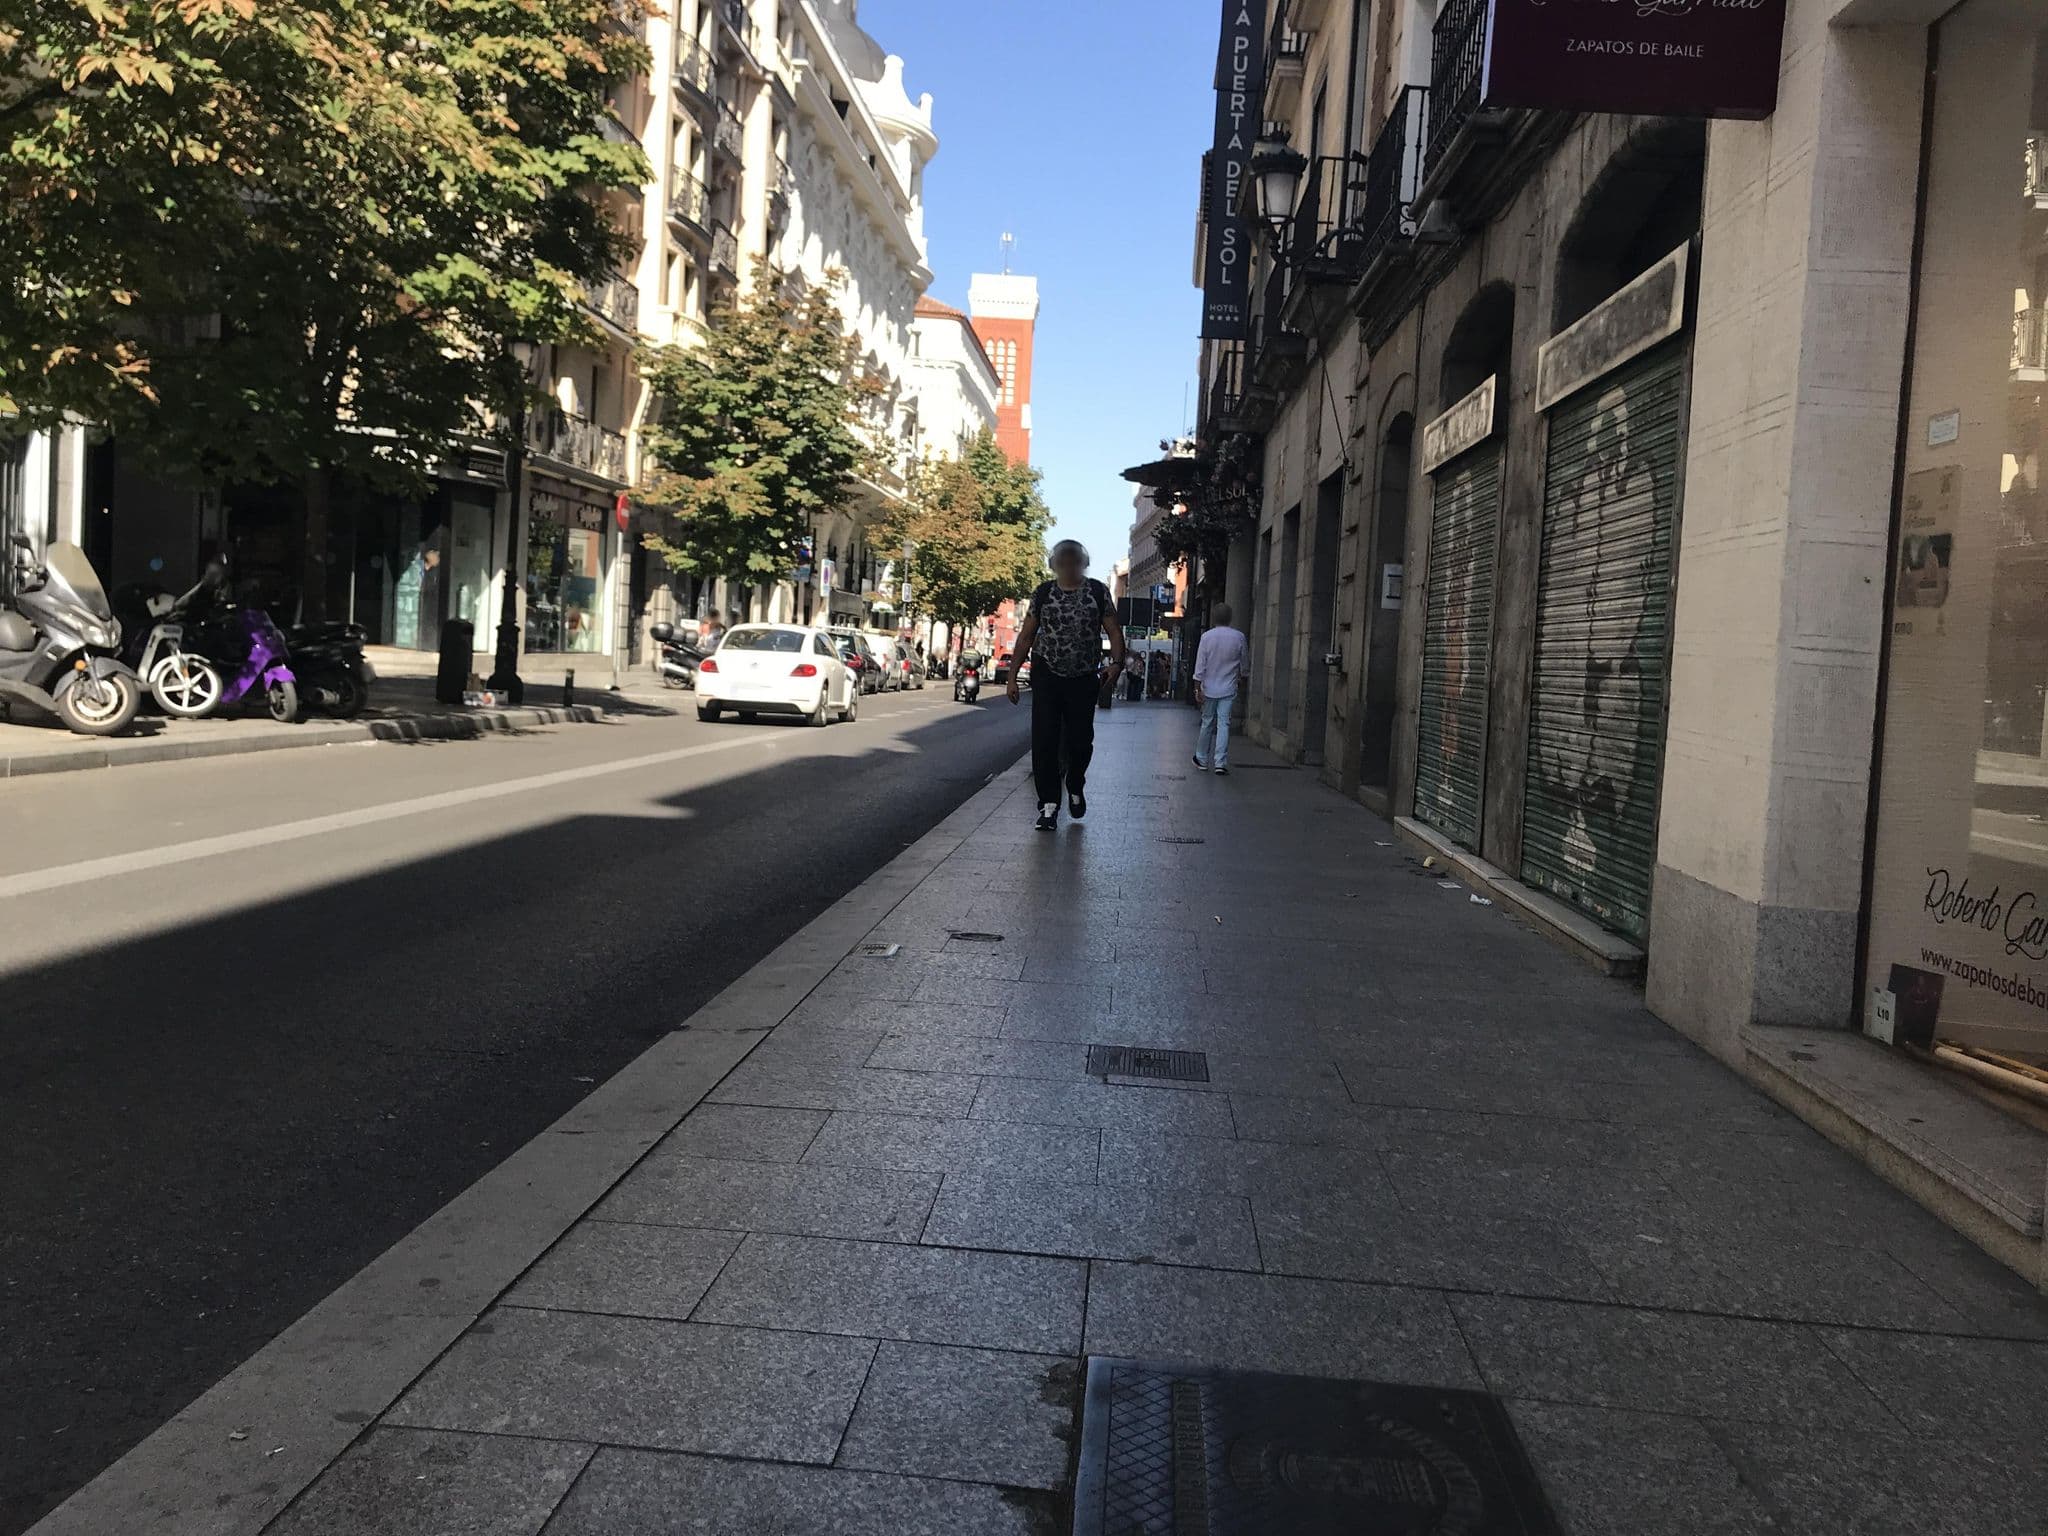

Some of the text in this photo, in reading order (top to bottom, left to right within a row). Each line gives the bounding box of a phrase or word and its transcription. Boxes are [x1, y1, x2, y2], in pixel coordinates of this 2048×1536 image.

[1566, 38, 1704, 59] ZAPATOS DE BAILE
[1227, 35, 1250, 150] PUERTA
[1225, 160, 1242, 217] DEL
[1219, 227, 1237, 285] SOL
[1208, 303, 1240, 314] HOTEL
[1923, 866, 2002, 932] Roberto
[1920, 946, 2048, 1012] www.zapatosdeba
